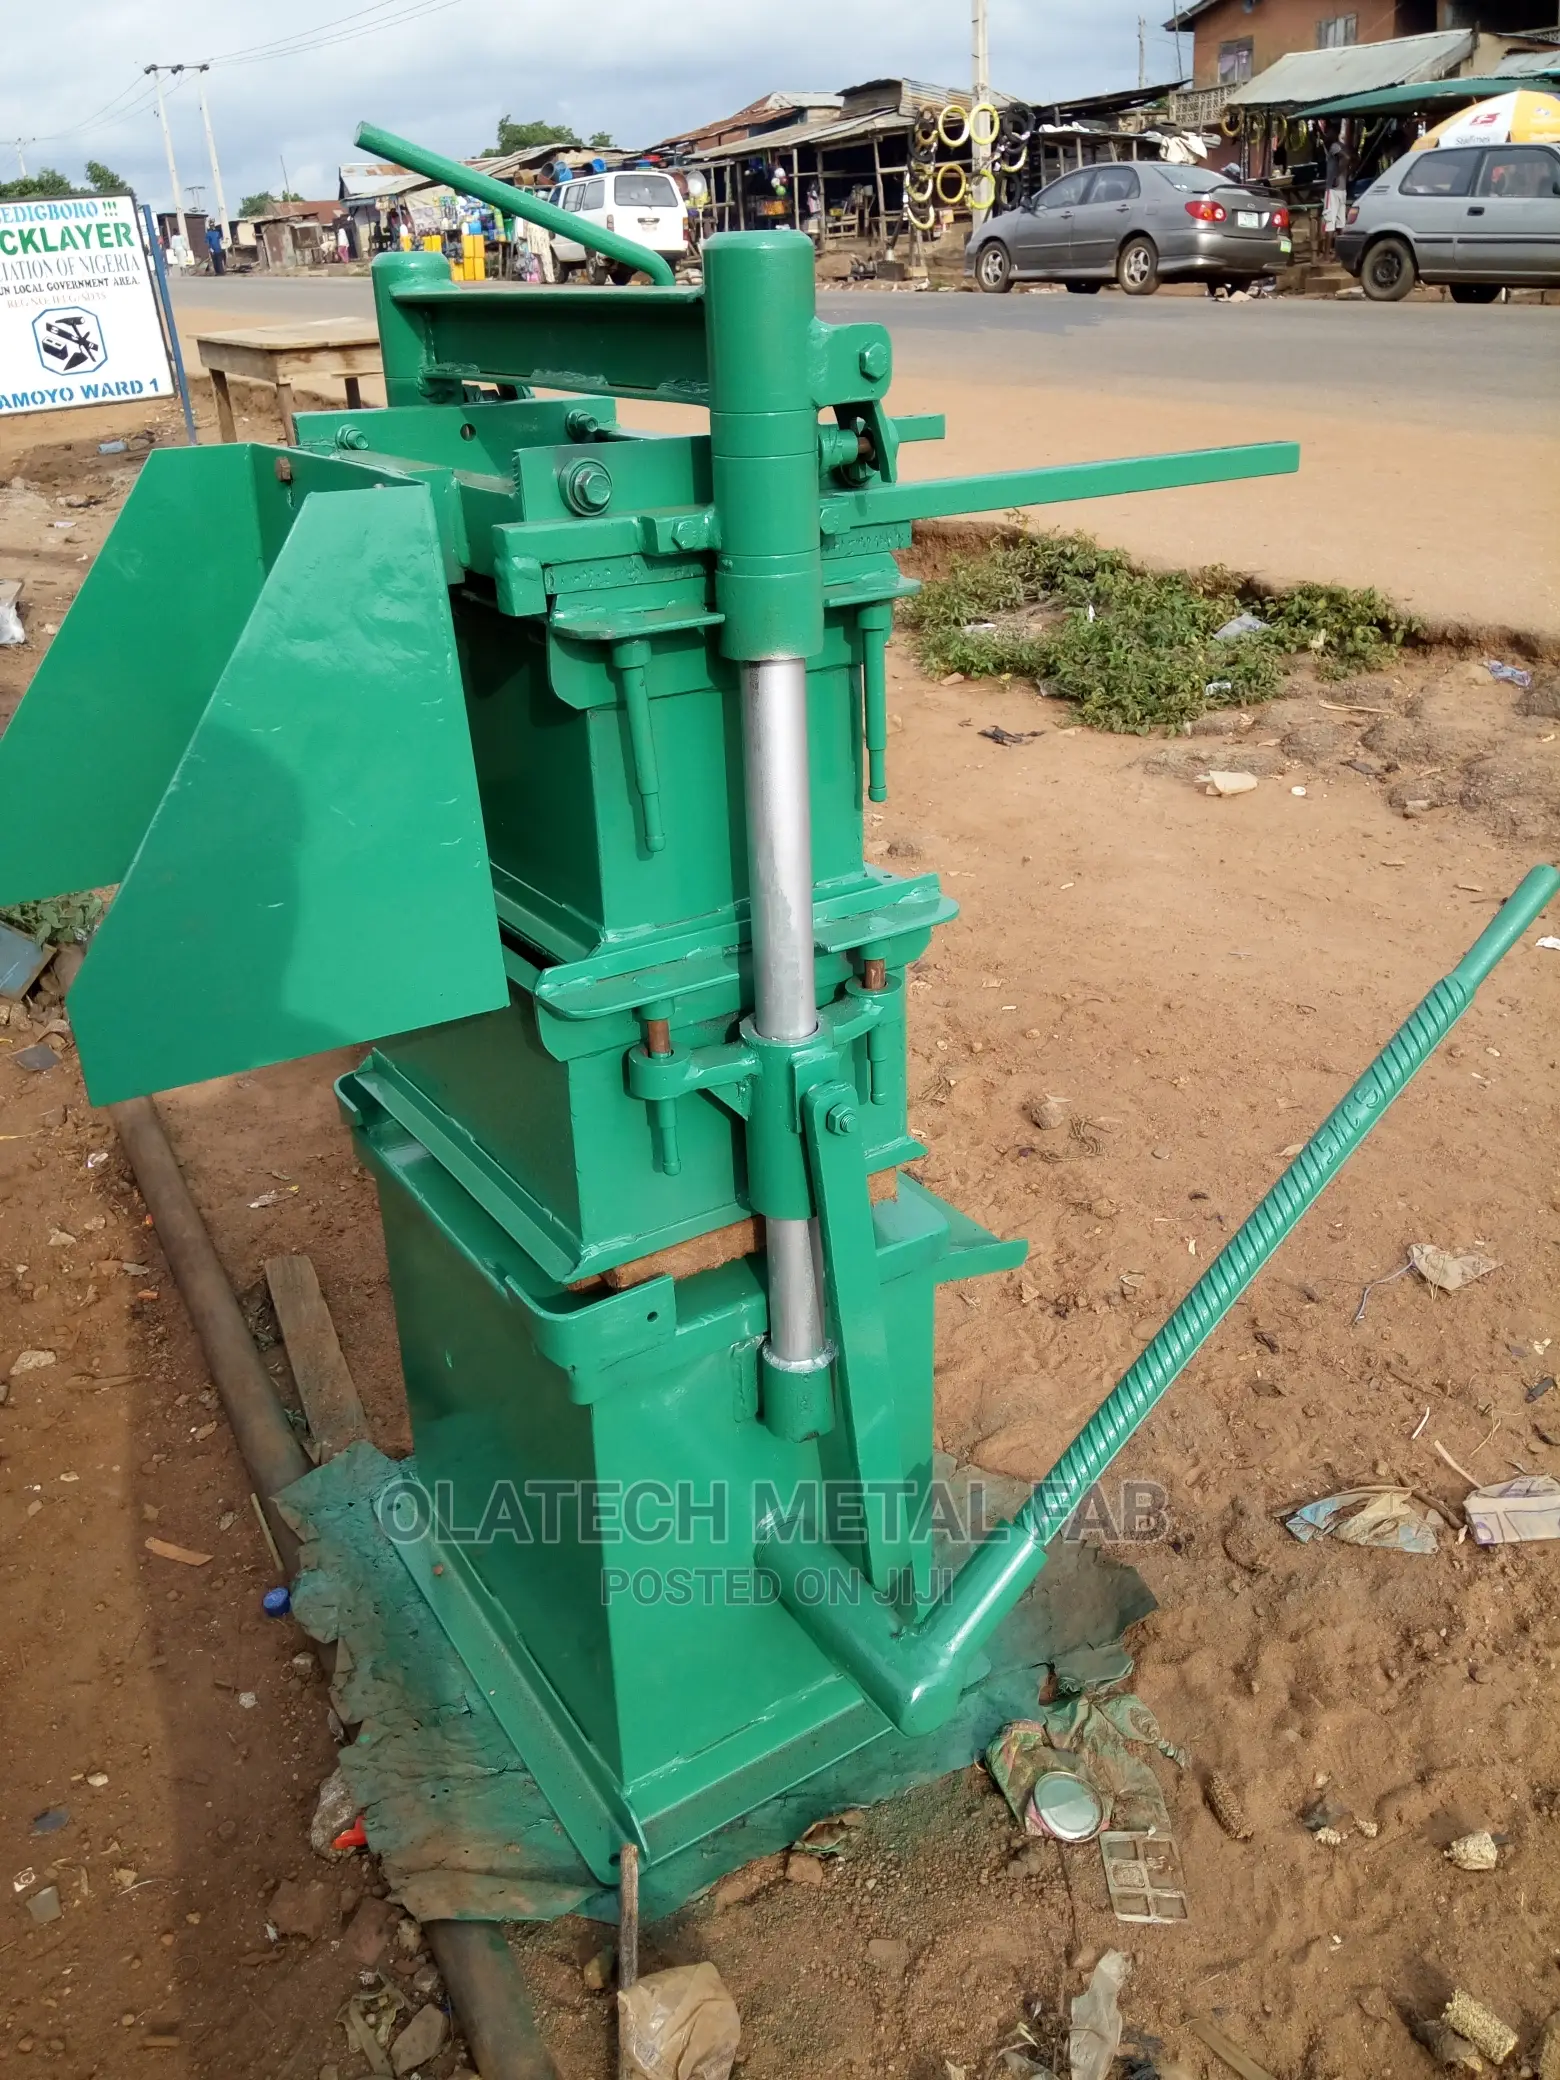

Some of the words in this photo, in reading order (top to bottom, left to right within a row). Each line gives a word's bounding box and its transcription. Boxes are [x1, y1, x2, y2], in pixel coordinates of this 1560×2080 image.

[0, 201, 98, 223] EDIGBORO
[0, 222, 134, 256] CKLAYER
[0, 259, 54, 282] IATION
[56, 256, 75, 276] OF
[78, 253, 141, 275] NIGERIA
[13, 283, 44, 295] LOCAL
[46, 278, 109, 292] GOVERNMENT
[80, 380, 144, 399] WARD
[149, 378, 159, 392] 1
